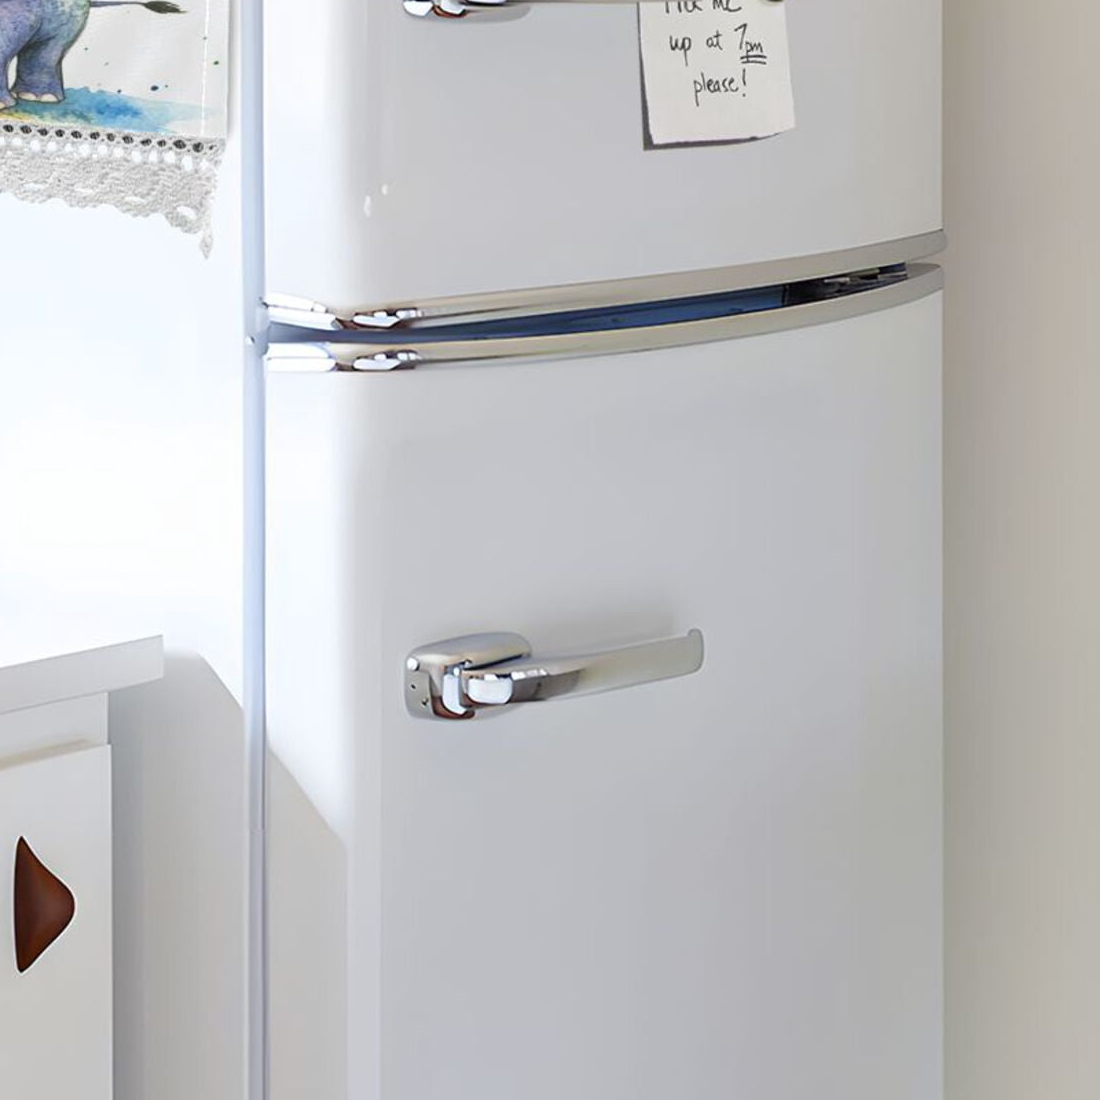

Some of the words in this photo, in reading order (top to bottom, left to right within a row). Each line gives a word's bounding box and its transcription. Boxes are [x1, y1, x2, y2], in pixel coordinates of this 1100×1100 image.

[669, 35, 692, 67] up
[706, 29, 723, 51] at
[693, 68, 747, 107] please!
